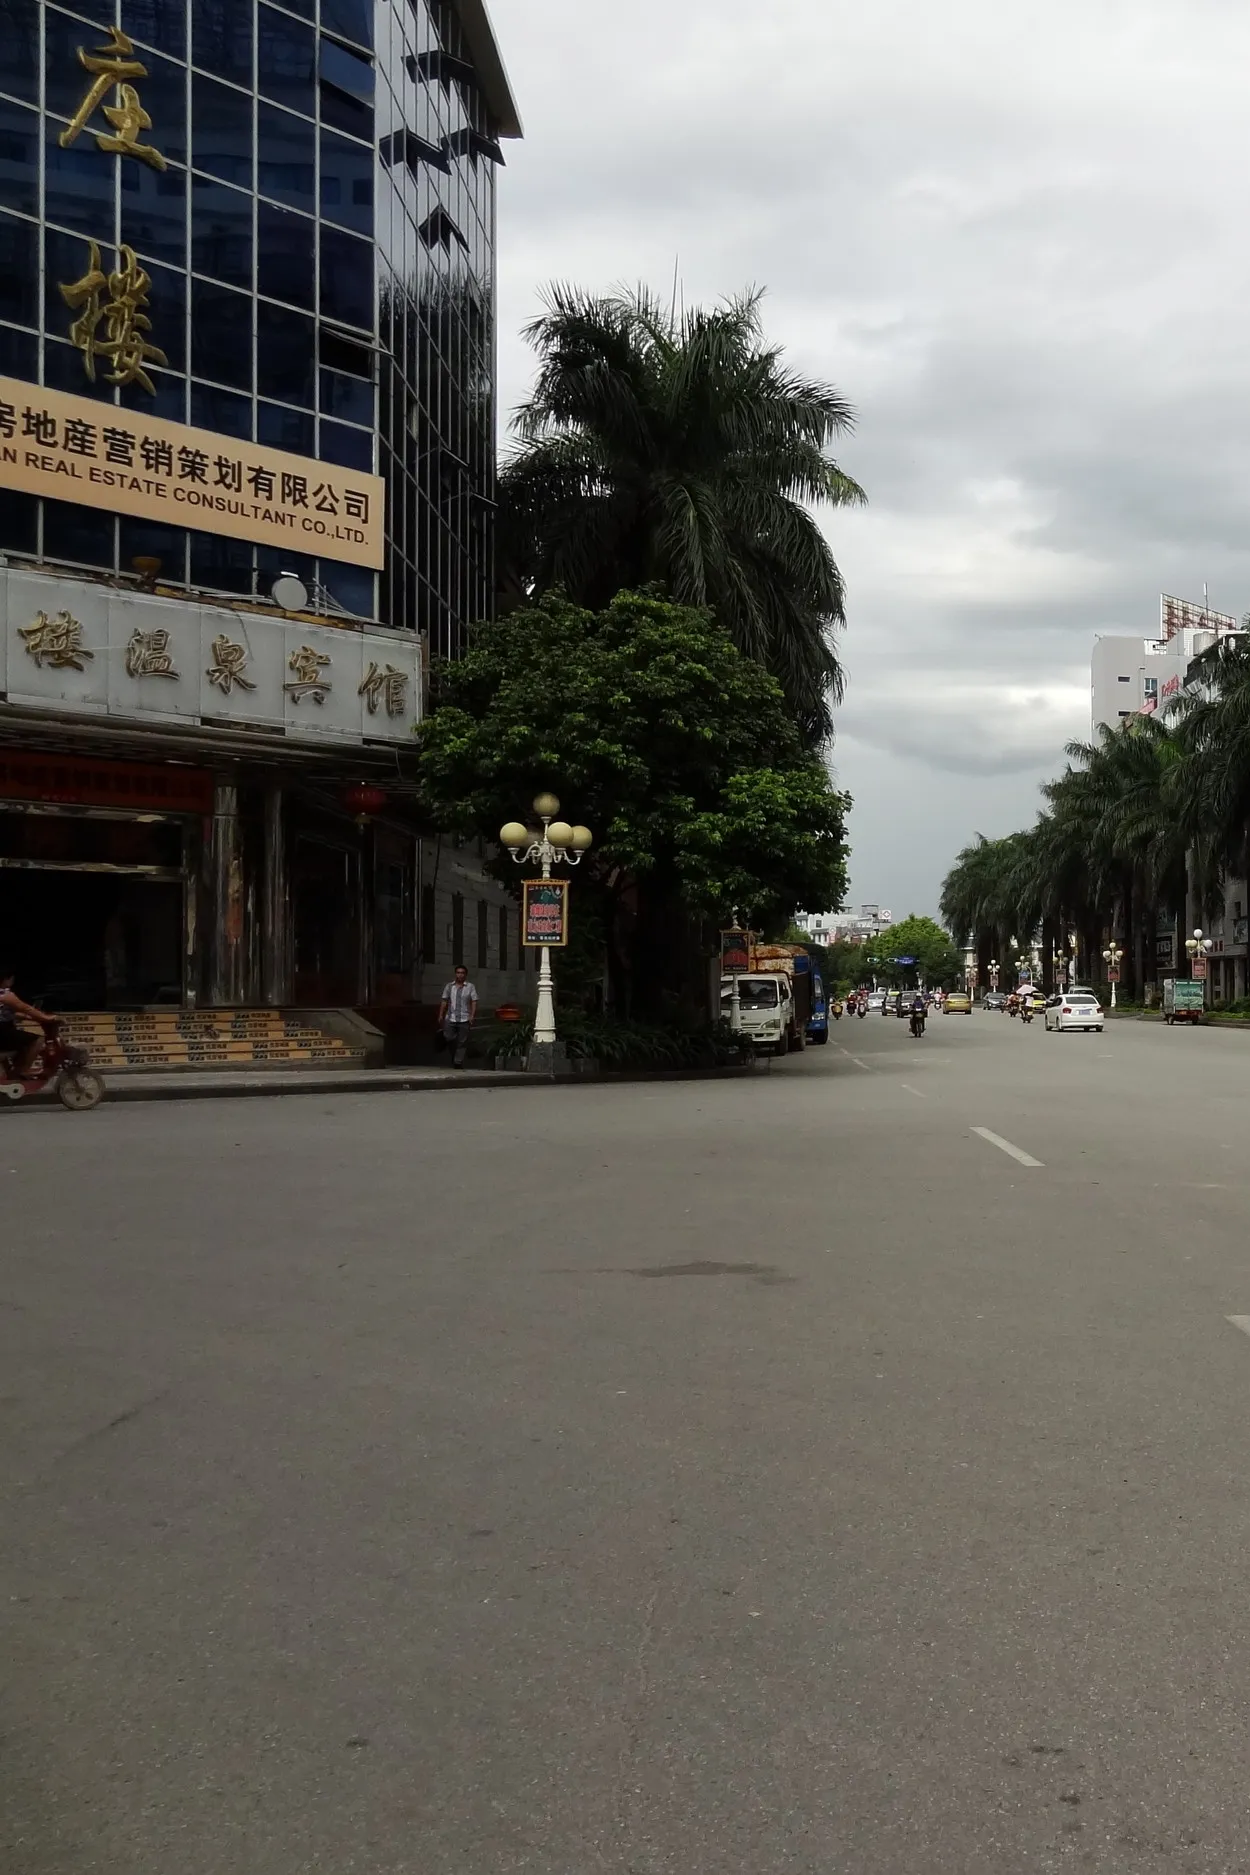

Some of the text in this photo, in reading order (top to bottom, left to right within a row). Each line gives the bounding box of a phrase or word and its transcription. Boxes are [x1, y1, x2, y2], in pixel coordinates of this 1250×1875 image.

[0, 446, 18, 464] N
[25, 452, 83, 479] REAL
[89, 466, 167, 499] ESTATE
[173, 488, 296, 527] CONSULTANT
